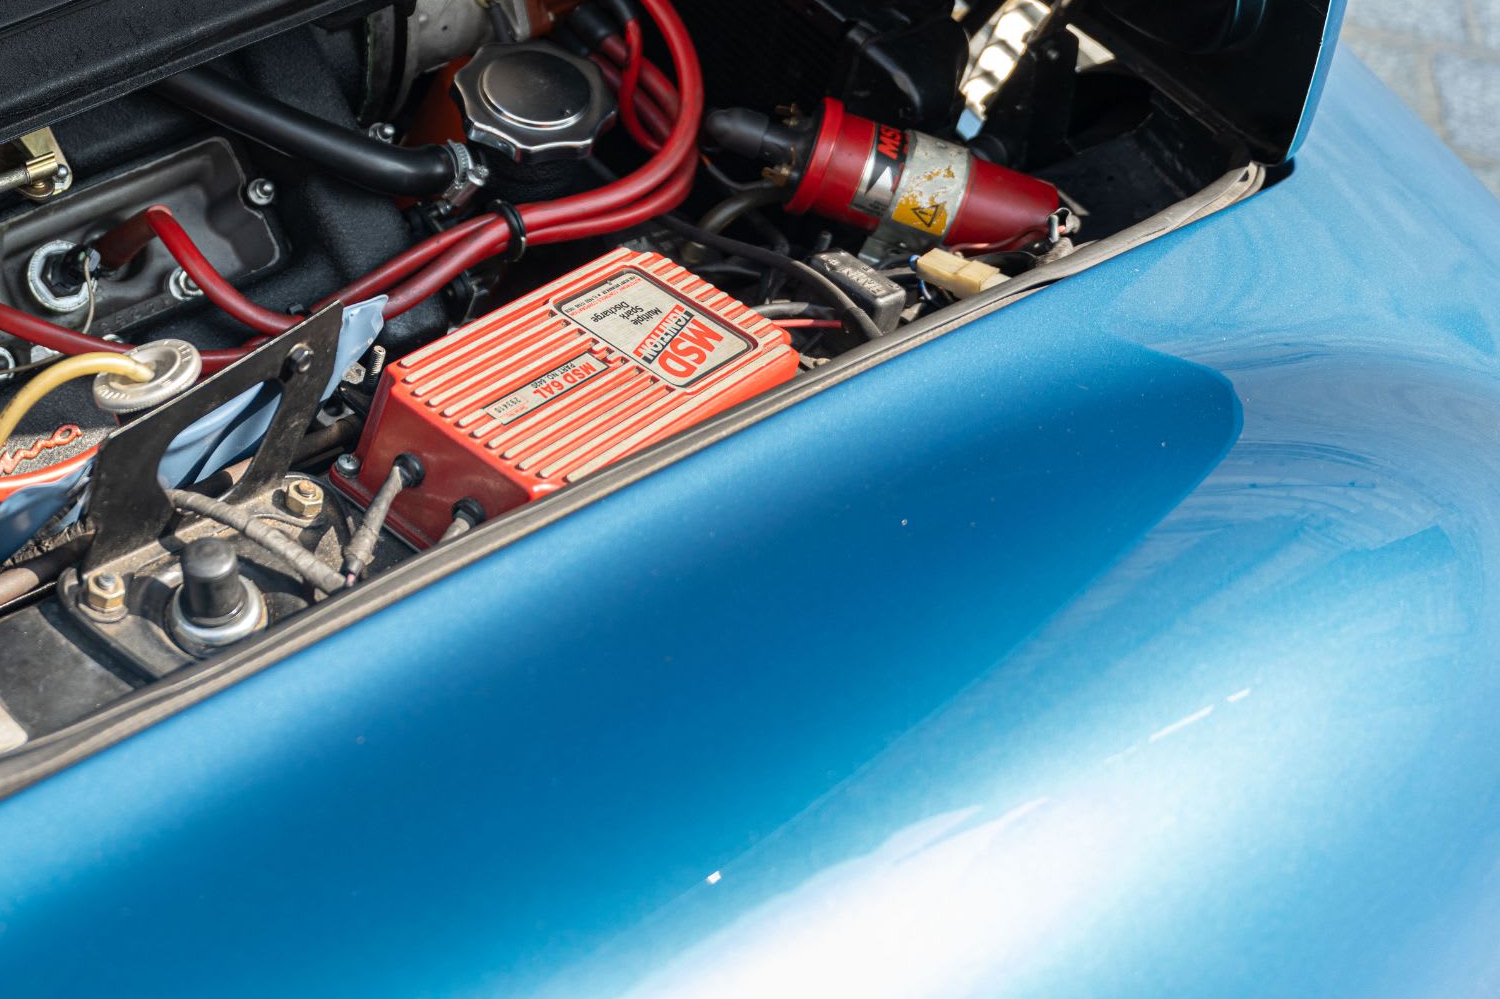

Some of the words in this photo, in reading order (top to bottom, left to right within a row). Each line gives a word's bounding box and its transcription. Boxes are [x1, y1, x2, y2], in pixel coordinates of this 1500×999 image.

[590, 301, 631, 323] Discharge
[619, 305, 644, 321] Spark
[630, 307, 663, 326] Multiple
[636, 308, 692, 360] IGNITION
[655, 317, 725, 378] MSD
[545, 372, 559, 381] NO.
[560, 362, 576, 374] PART
[562, 362, 597, 384] MSD
[532, 382, 564, 399] 6AL
